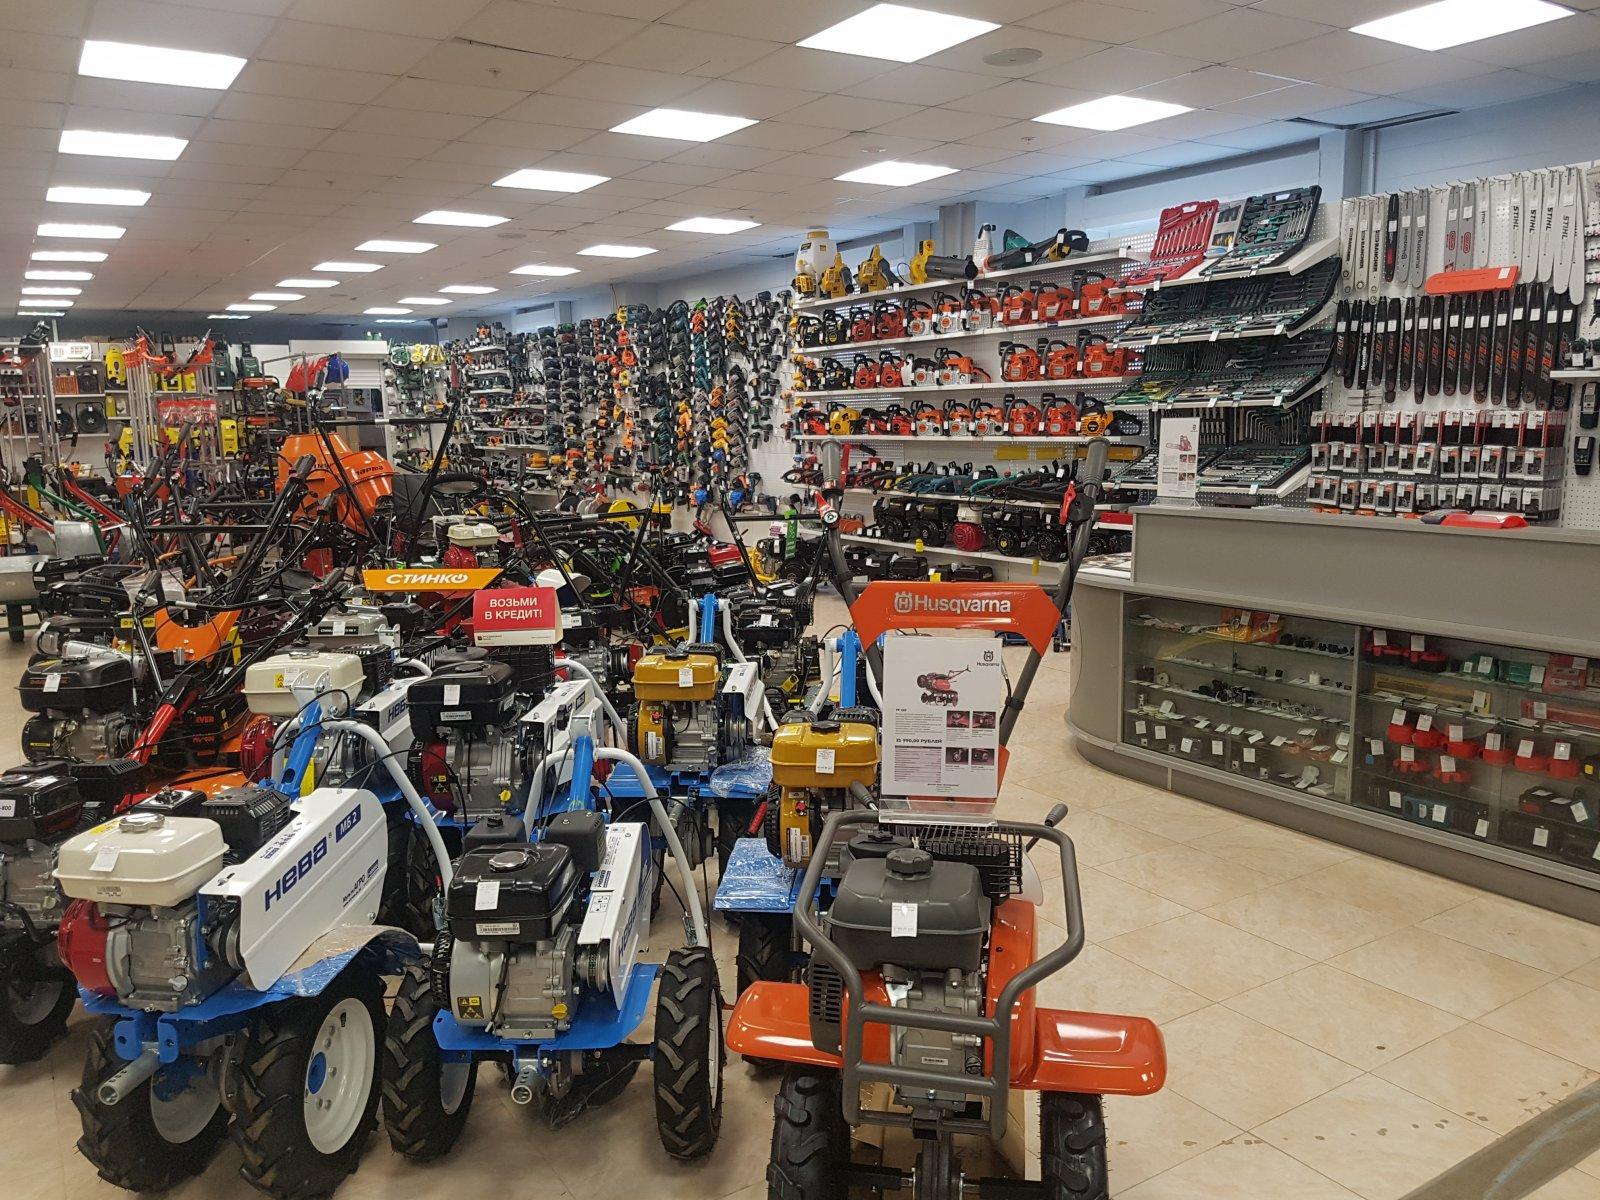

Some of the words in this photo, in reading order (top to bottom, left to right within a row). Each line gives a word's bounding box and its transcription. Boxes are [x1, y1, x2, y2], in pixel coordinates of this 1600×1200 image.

[1561, 215, 1569, 240] STIHL
[385, 573, 469, 585] СТИНКО
[489, 597, 538, 608] ВОЗЬМИ
[914, 594, 1011, 614] Husqvarna
[484, 611, 493, 620] В
[495, 609, 543, 620] КРЕДИТ!
